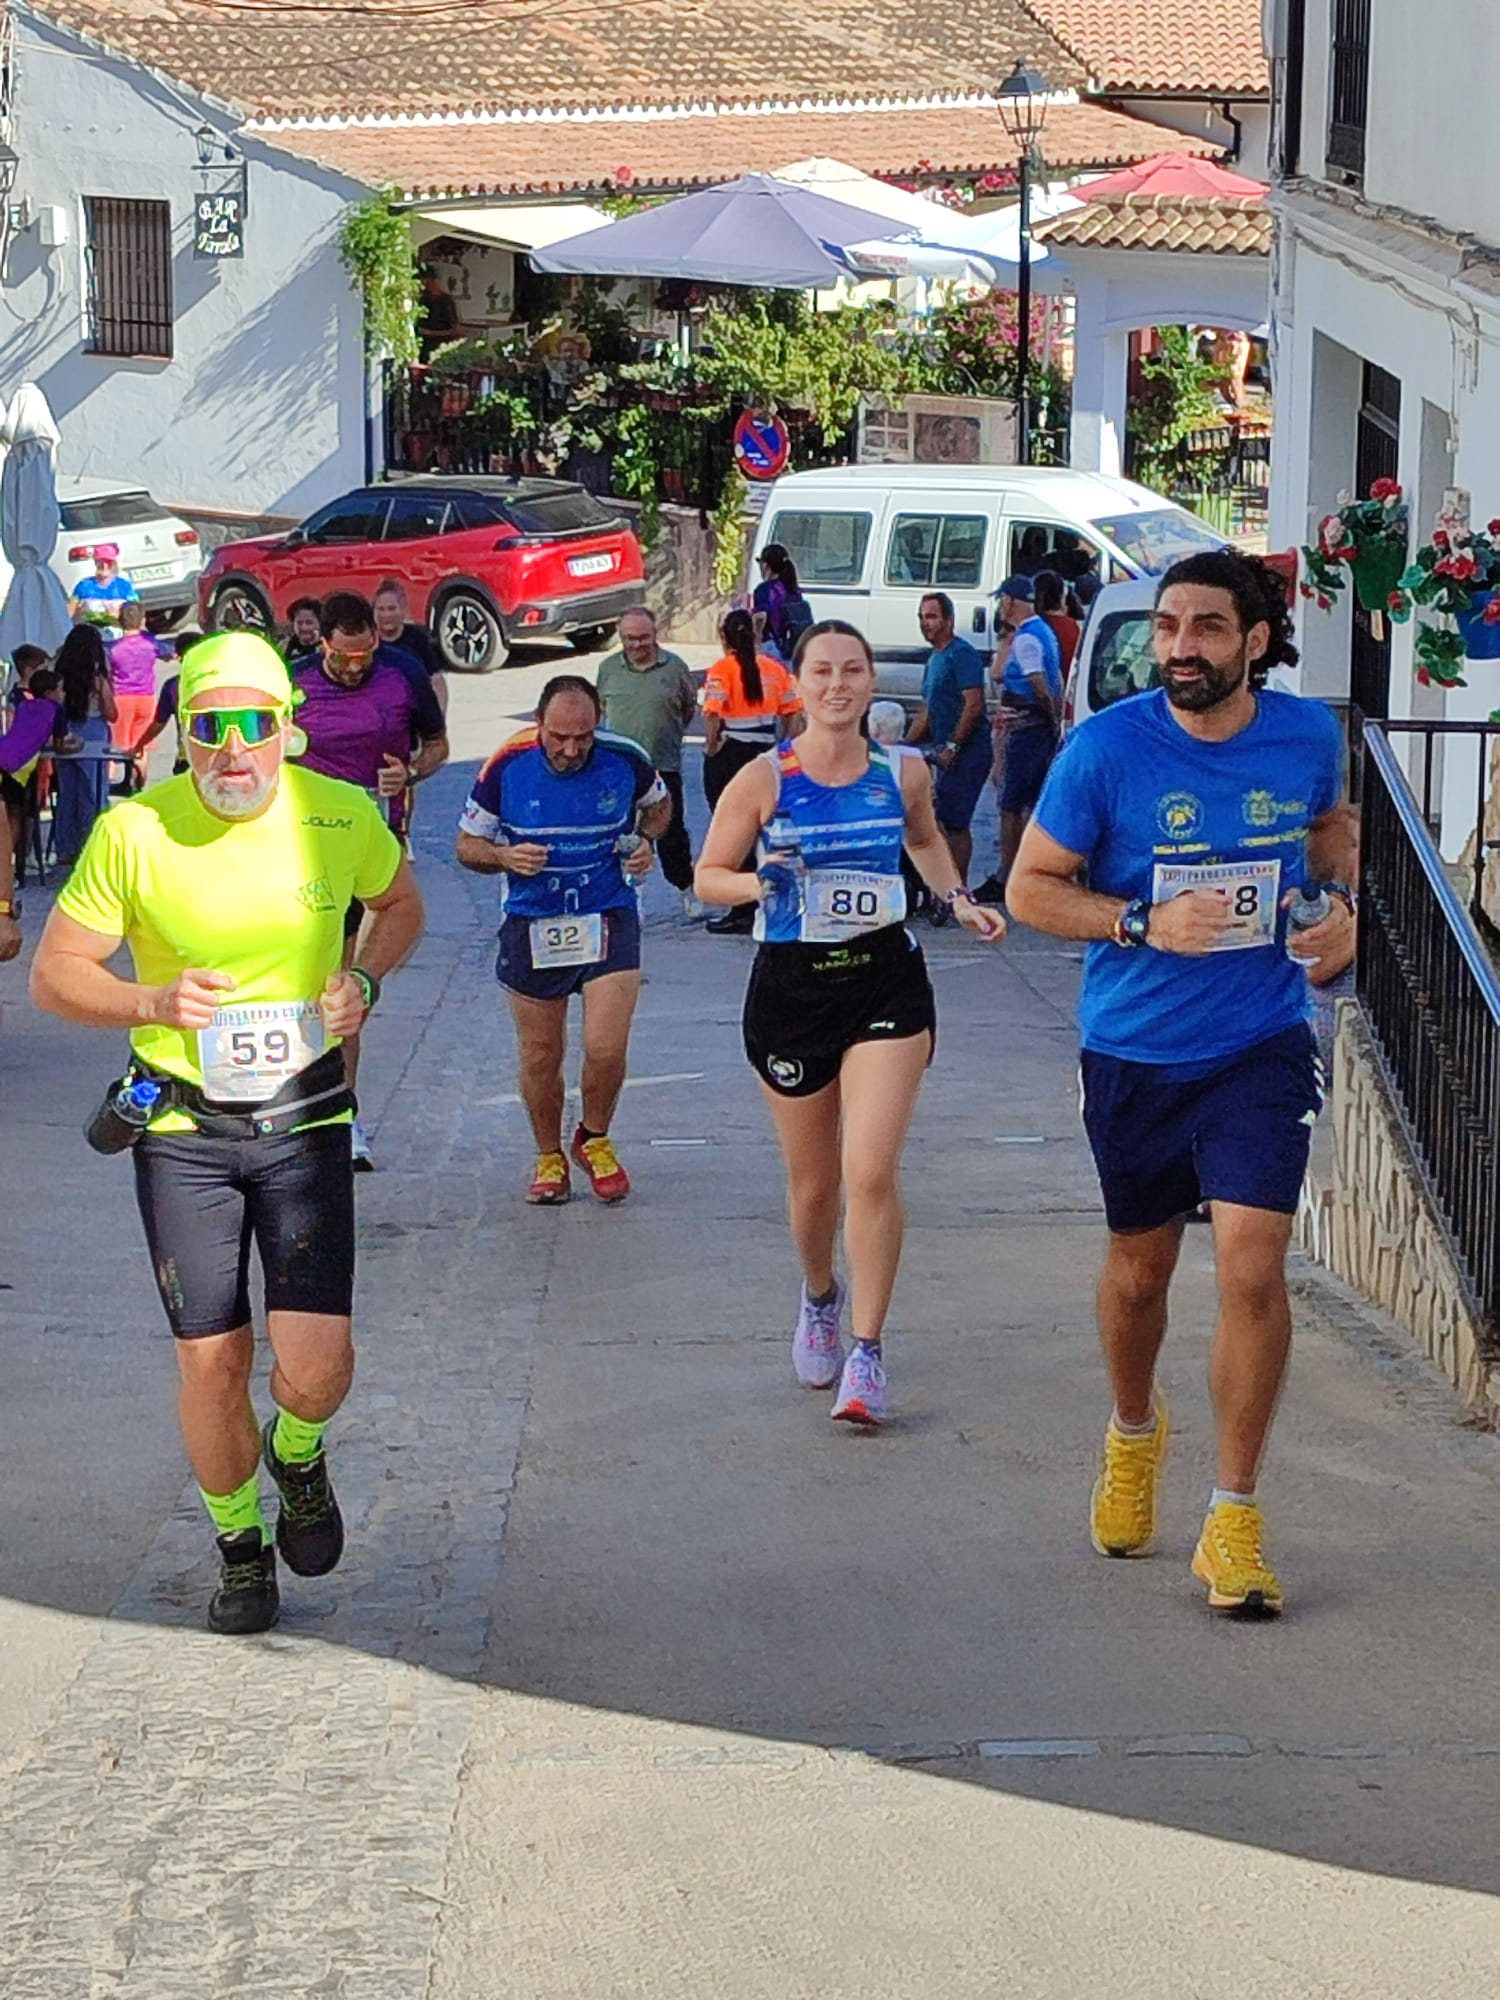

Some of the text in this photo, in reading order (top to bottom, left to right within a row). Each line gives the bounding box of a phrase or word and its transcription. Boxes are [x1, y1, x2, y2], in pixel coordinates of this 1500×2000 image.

[209, 215, 228, 233] La
[831, 889, 878, 916] 80
[547, 926, 580, 947] 32
[231, 1029, 290, 1065] 59
